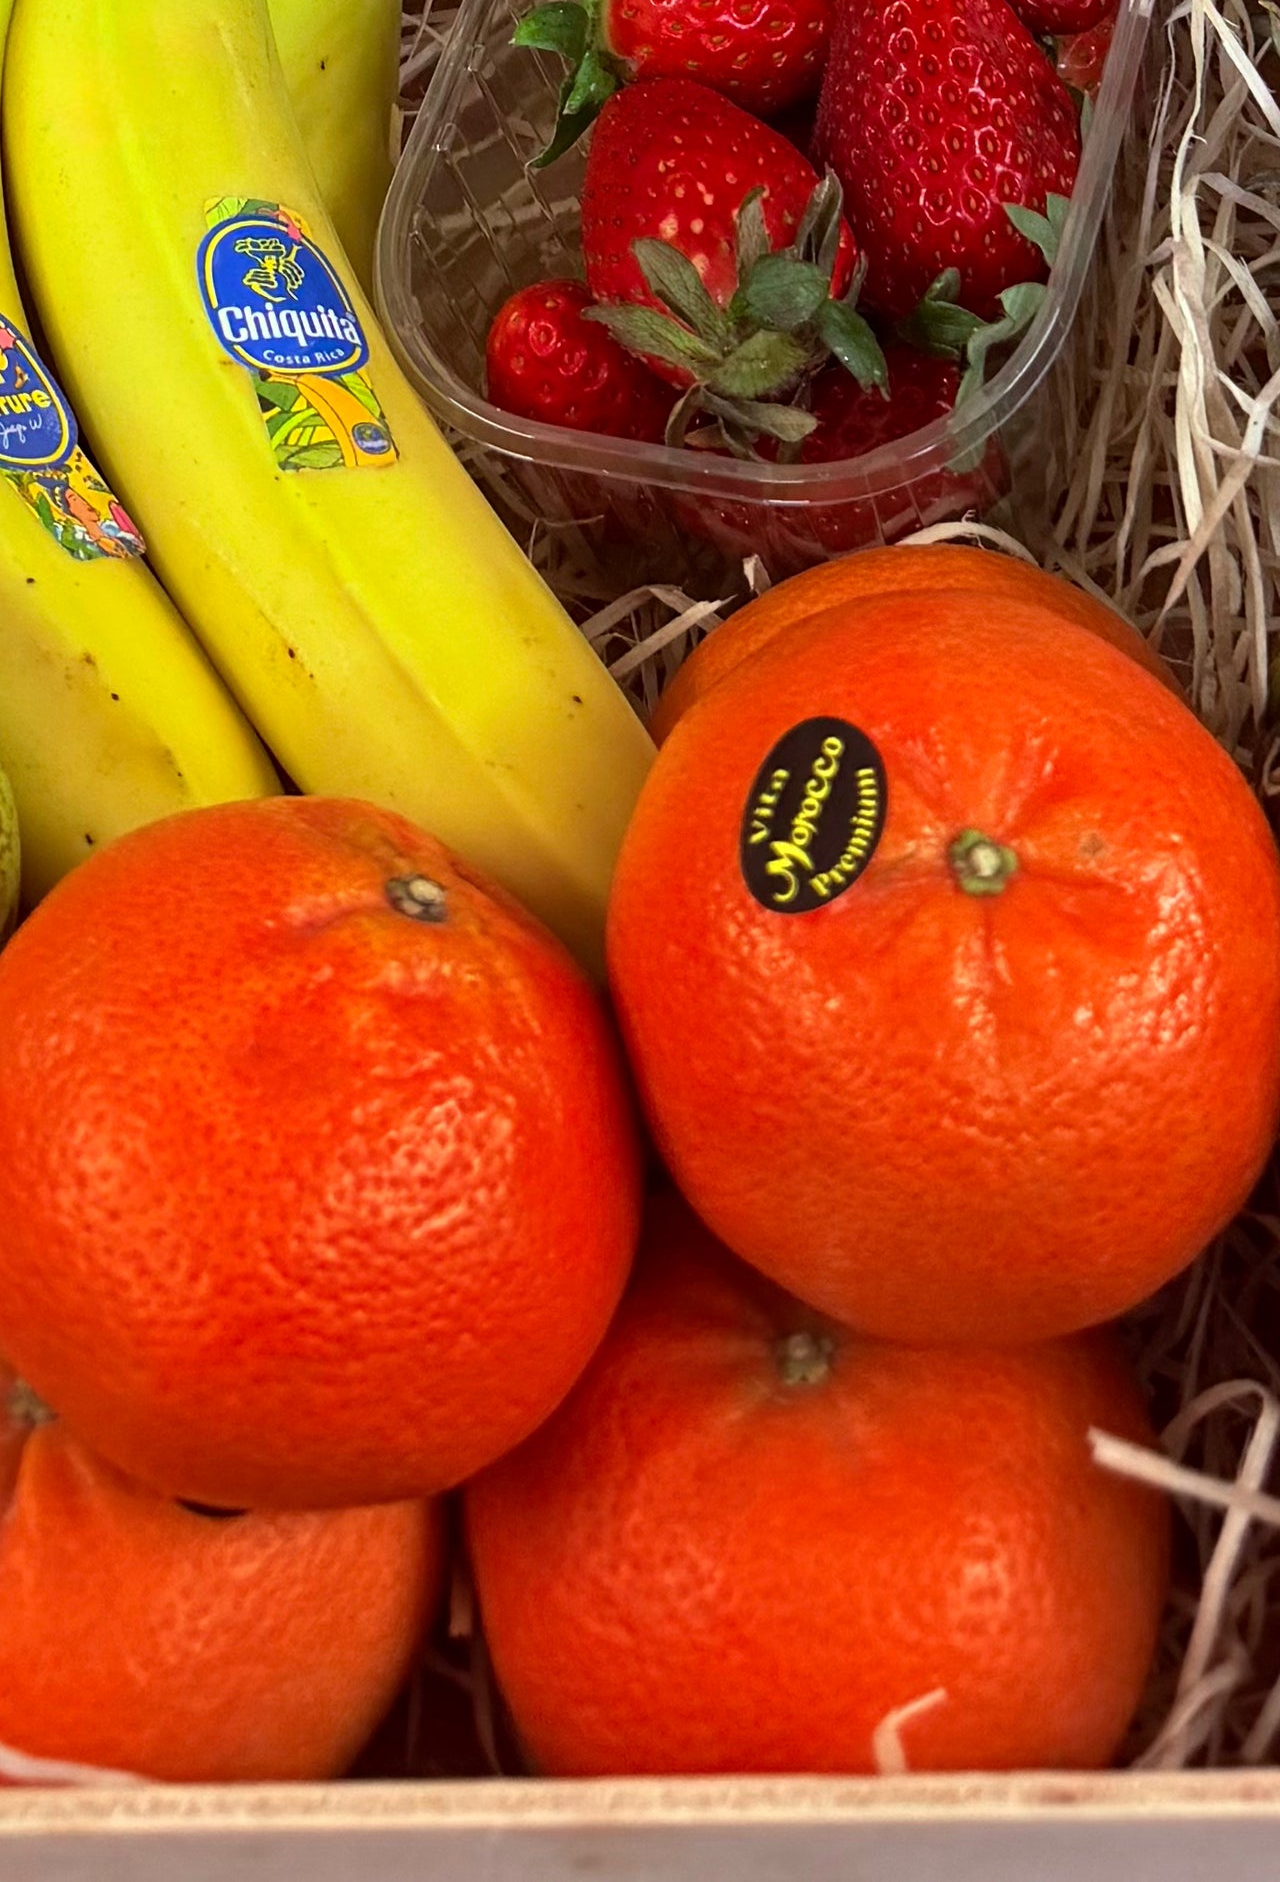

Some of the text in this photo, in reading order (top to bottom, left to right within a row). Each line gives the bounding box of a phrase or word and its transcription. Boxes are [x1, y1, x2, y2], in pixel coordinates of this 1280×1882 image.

[217, 301, 362, 348] Chiquita
[262, 347, 346, 366] Costa Rica
[749, 768, 791, 844] Vita
[765, 735, 845, 904] Morocco
[809, 768, 878, 897] Premium
